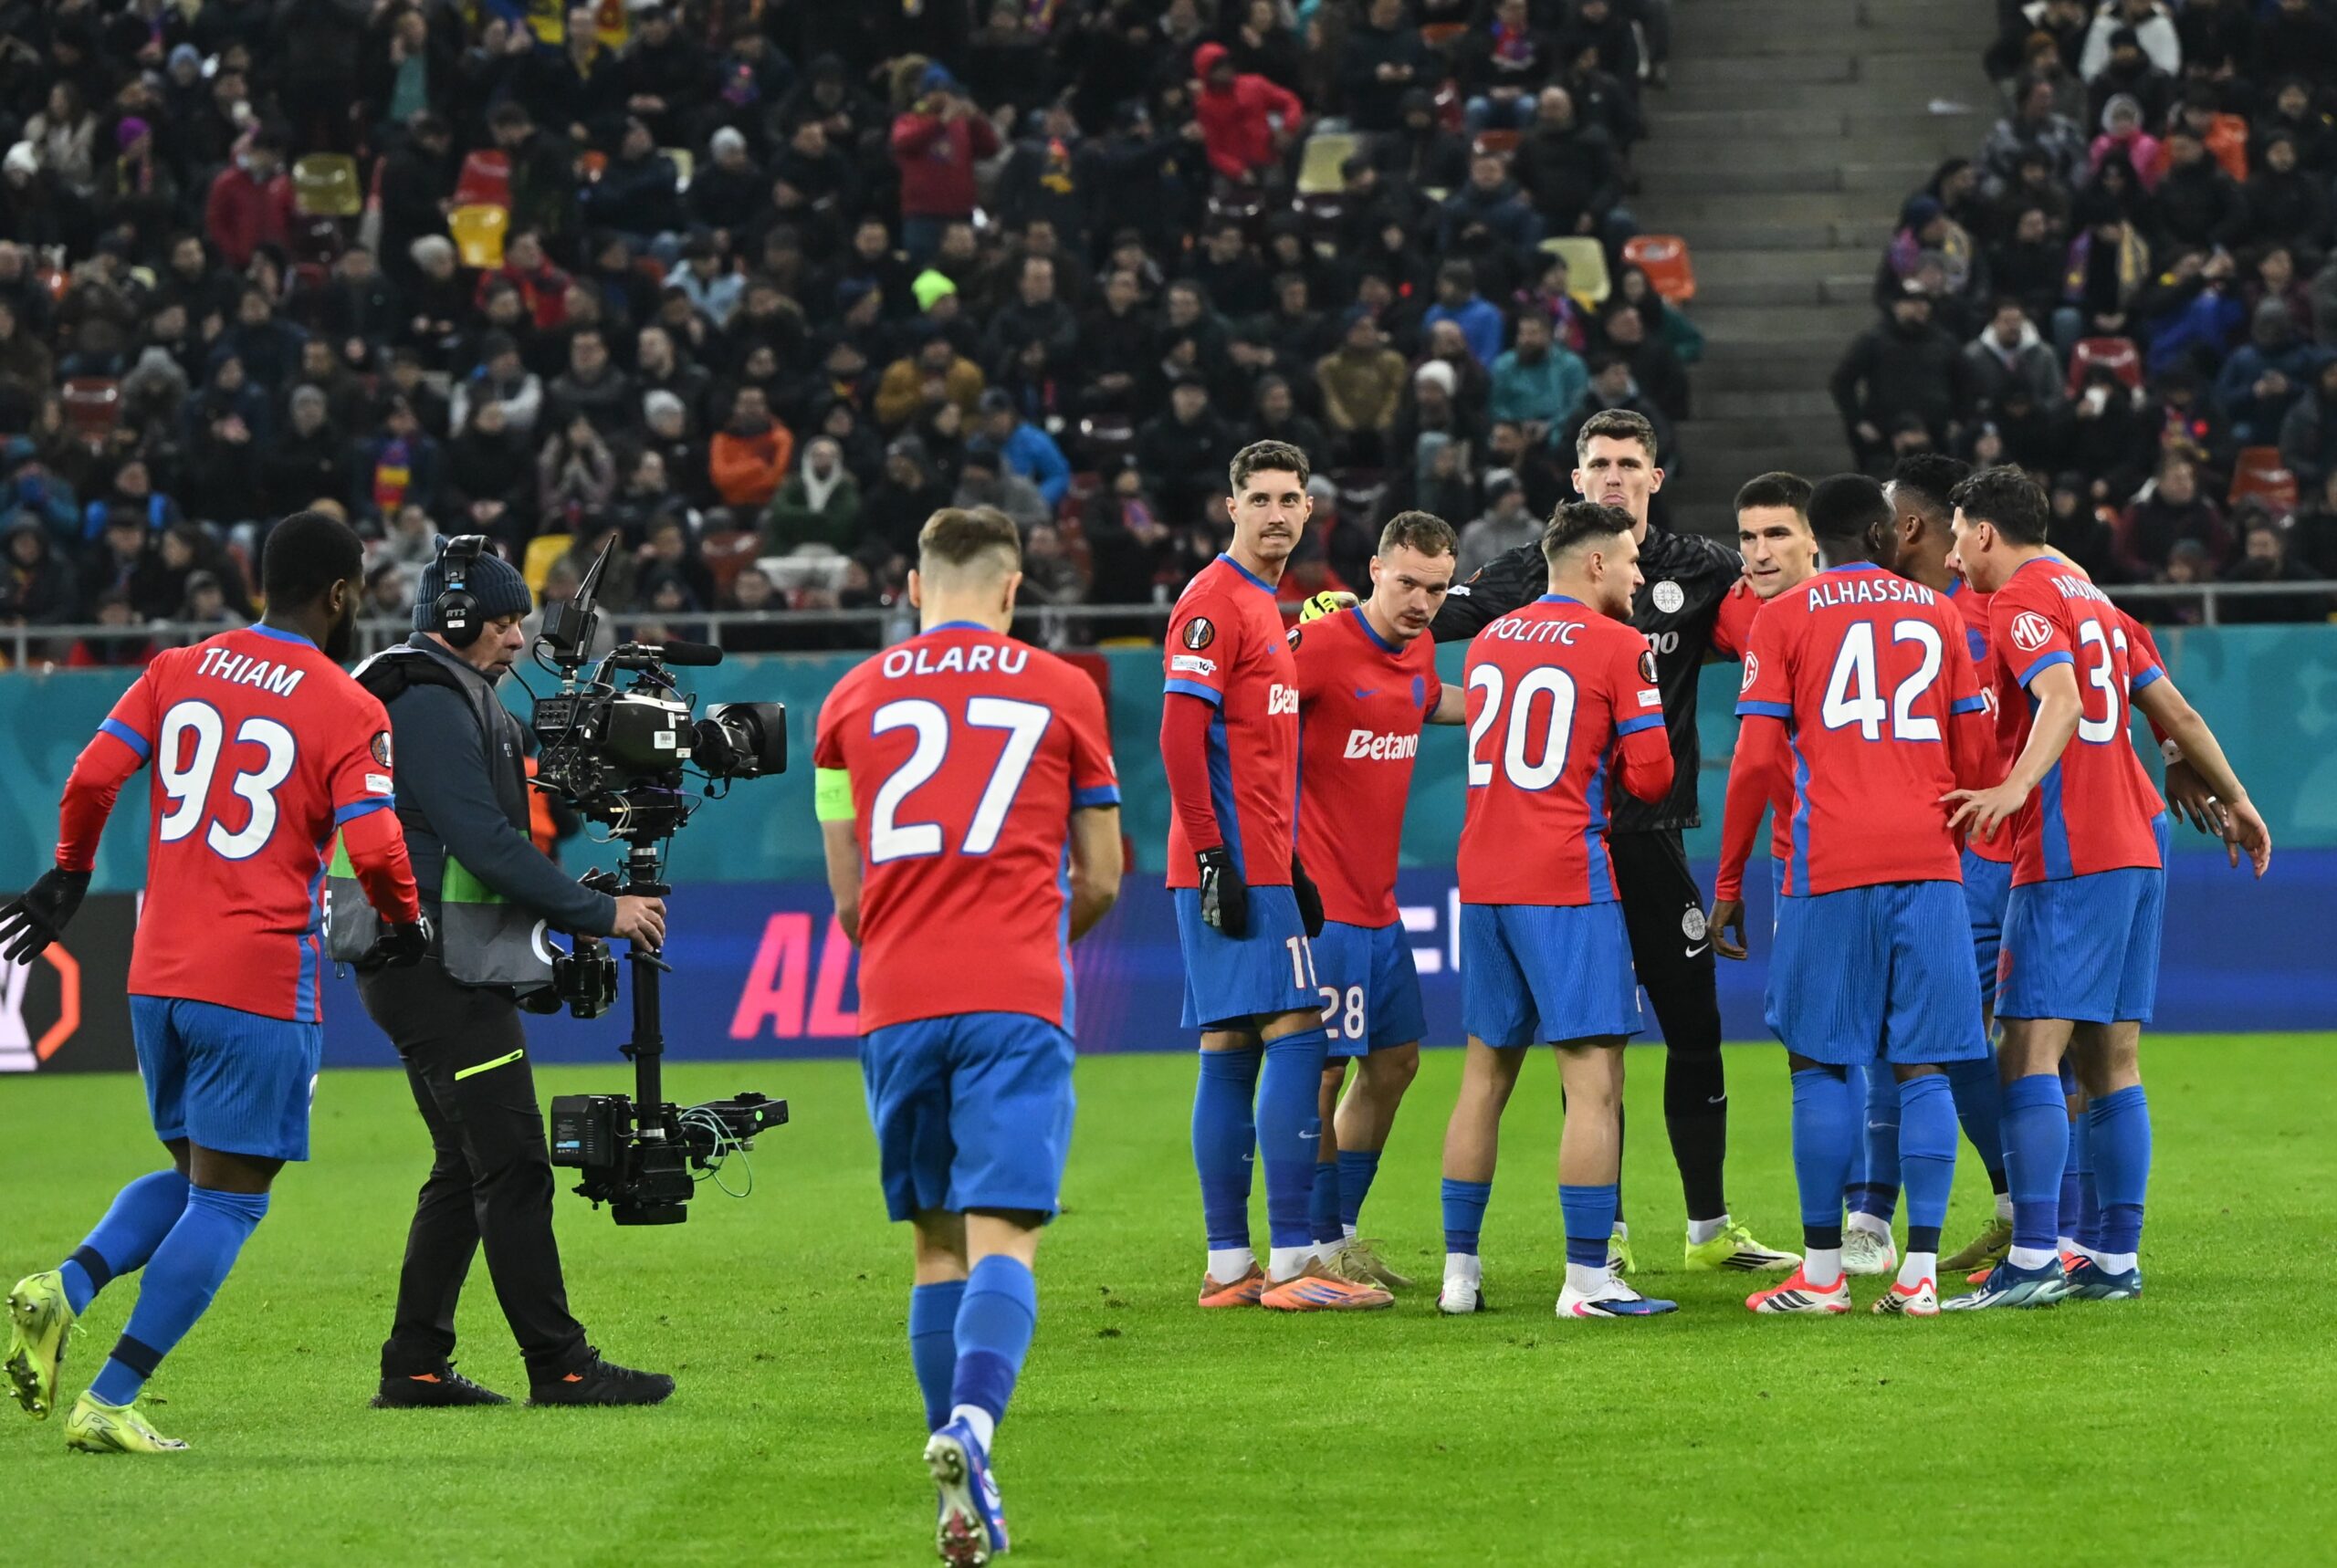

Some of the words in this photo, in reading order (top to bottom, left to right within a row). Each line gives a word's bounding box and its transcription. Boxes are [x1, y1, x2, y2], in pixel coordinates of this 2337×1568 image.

[1808, 579, 1935, 612] ALHASSAN
[1483, 617, 1587, 646] POLITIC
[2013, 613, 2050, 649] MG
[196, 646, 305, 698] THIAM
[882, 643, 1029, 679] OLARU
[1821, 619, 1944, 741] 42
[1343, 728, 1419, 760] Betano
[1468, 663, 1576, 790] 20
[159, 698, 298, 860] 93
[869, 696, 1052, 863] 27
[1285, 936, 1318, 989] 11
[1318, 986, 1365, 1040] 28
